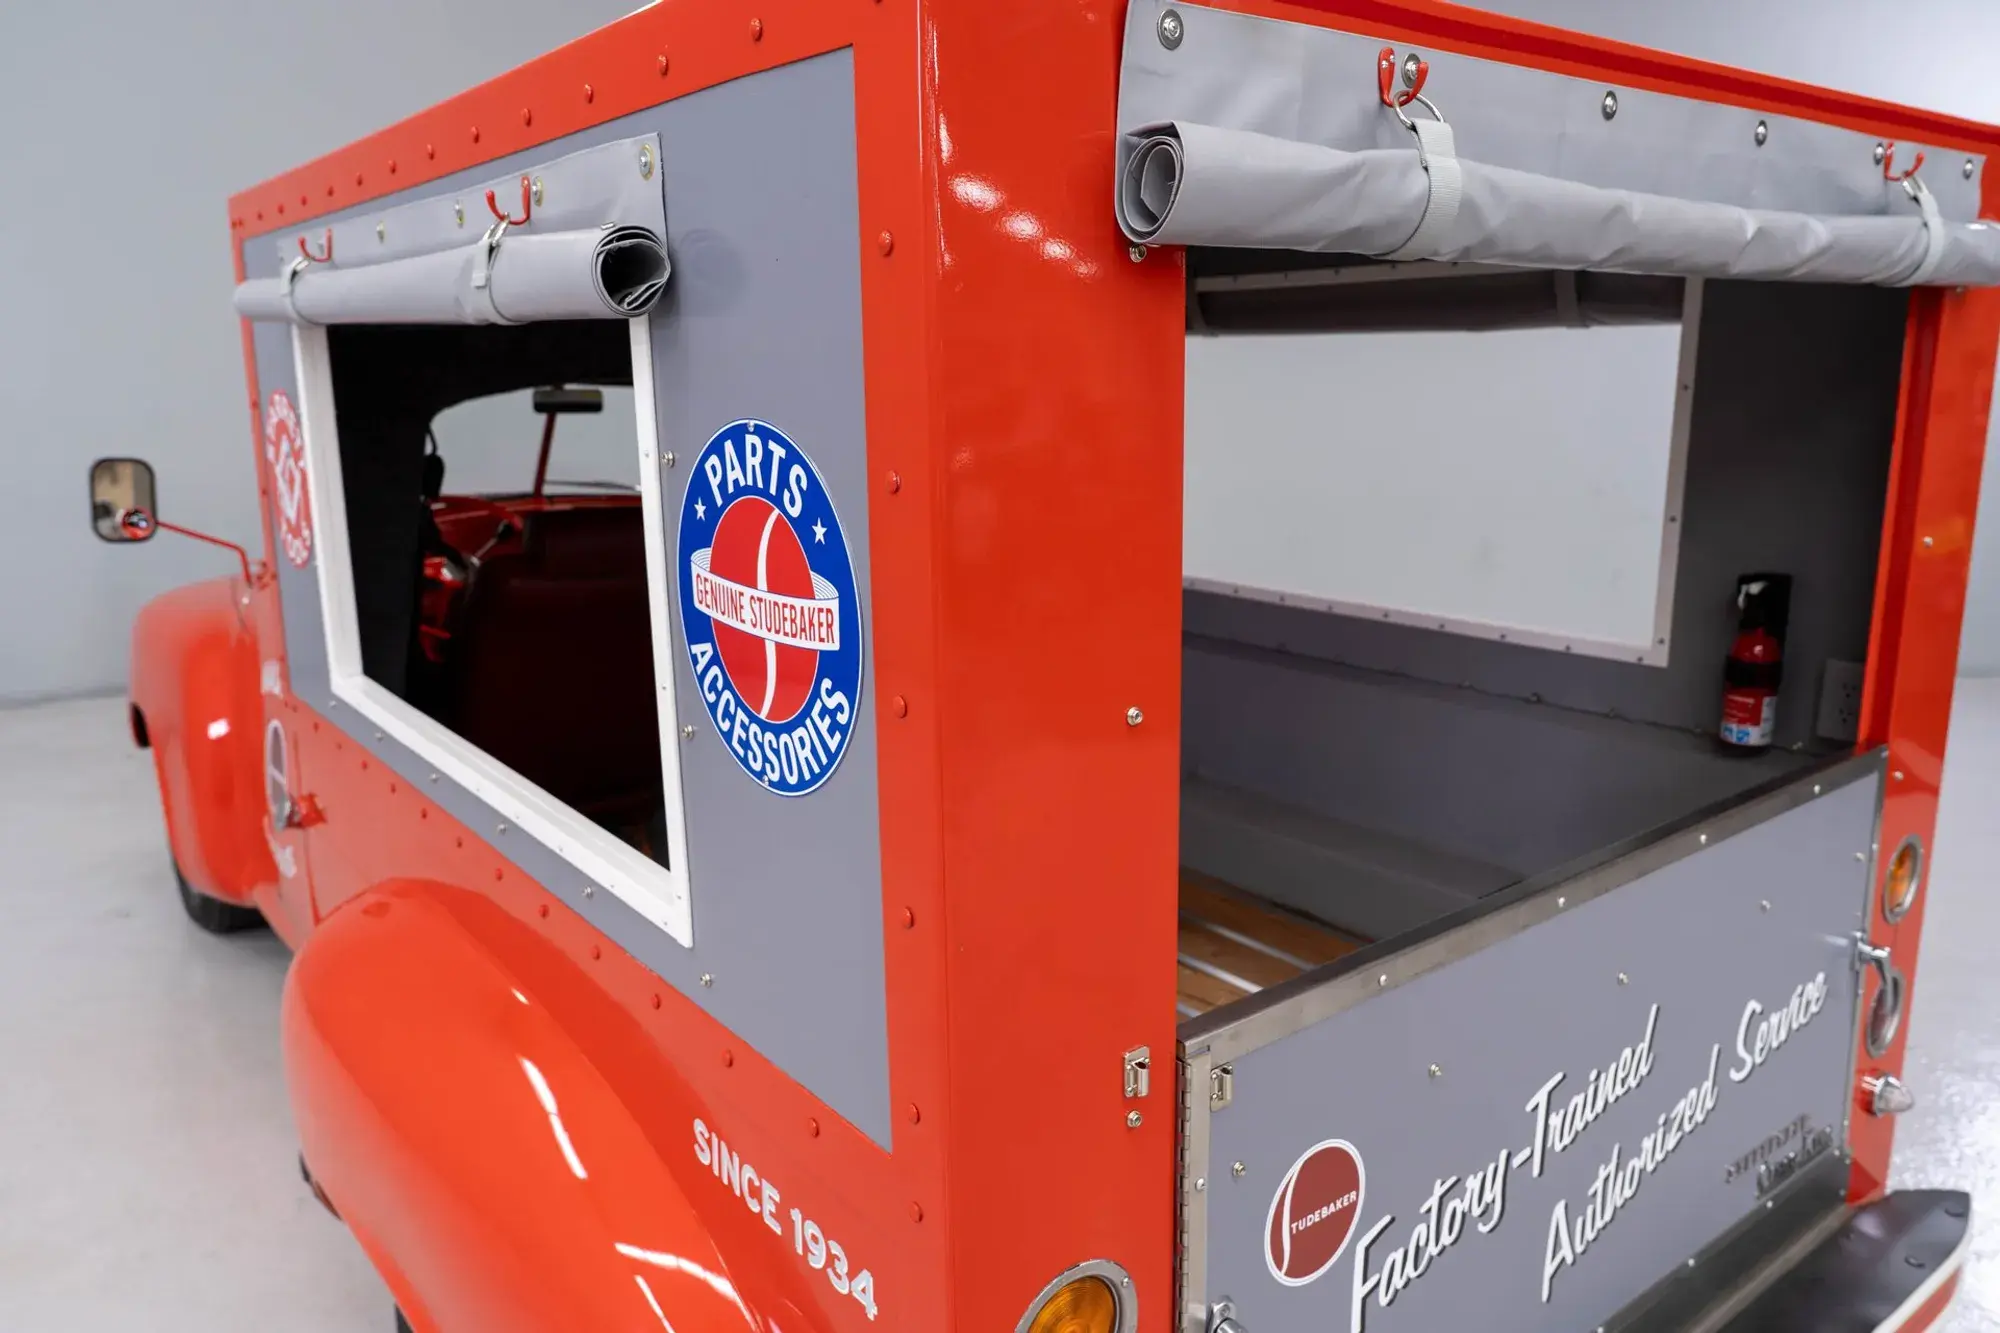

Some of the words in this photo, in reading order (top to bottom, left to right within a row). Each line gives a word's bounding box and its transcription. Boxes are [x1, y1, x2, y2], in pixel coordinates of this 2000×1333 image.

[704, 434, 808, 518] PARTS
[695, 573, 746, 625] GENUINE
[749, 597, 835, 644] STUDEBAKER
[690, 642, 850, 785] ACCESSORIES
[1541, 1043, 1721, 1303] Authorized
[1729, 972, 1827, 1082] Service
[693, 1118, 782, 1236] SINCE
[790, 1208, 878, 1321] 1934
